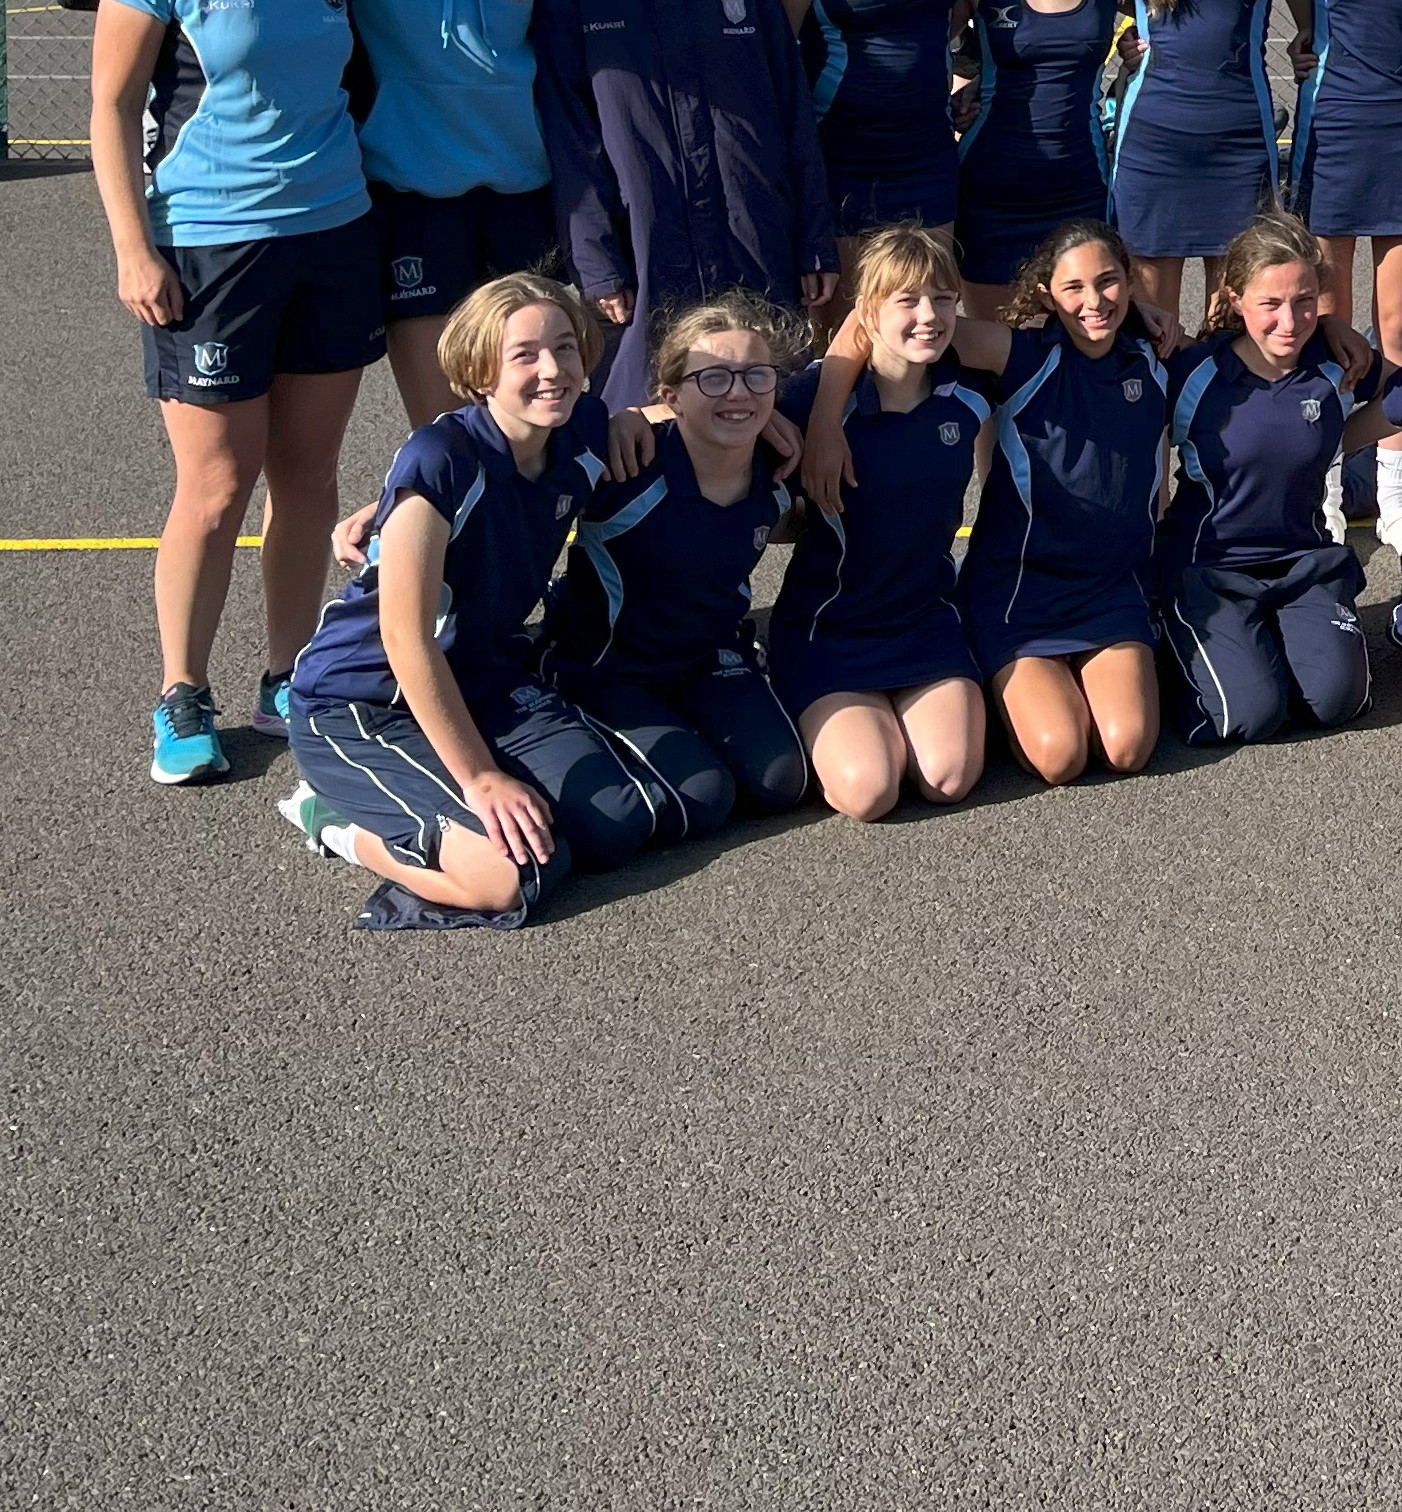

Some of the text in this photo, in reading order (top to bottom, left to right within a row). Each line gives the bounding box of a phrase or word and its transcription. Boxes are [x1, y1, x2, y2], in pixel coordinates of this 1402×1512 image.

[209, 0, 255, 11] KUKRI
[726, 2, 741, 16] M
[589, 19, 625, 33] KUKRI
[398, 263, 418, 281] M
[391, 286, 437, 301] MAYNARD
[201, 348, 222, 367] M
[188, 375, 240, 387] MAYNARD
[1127, 385, 1139, 396] M
[1305, 405, 1318, 416] M
[944, 426, 956, 440] M
